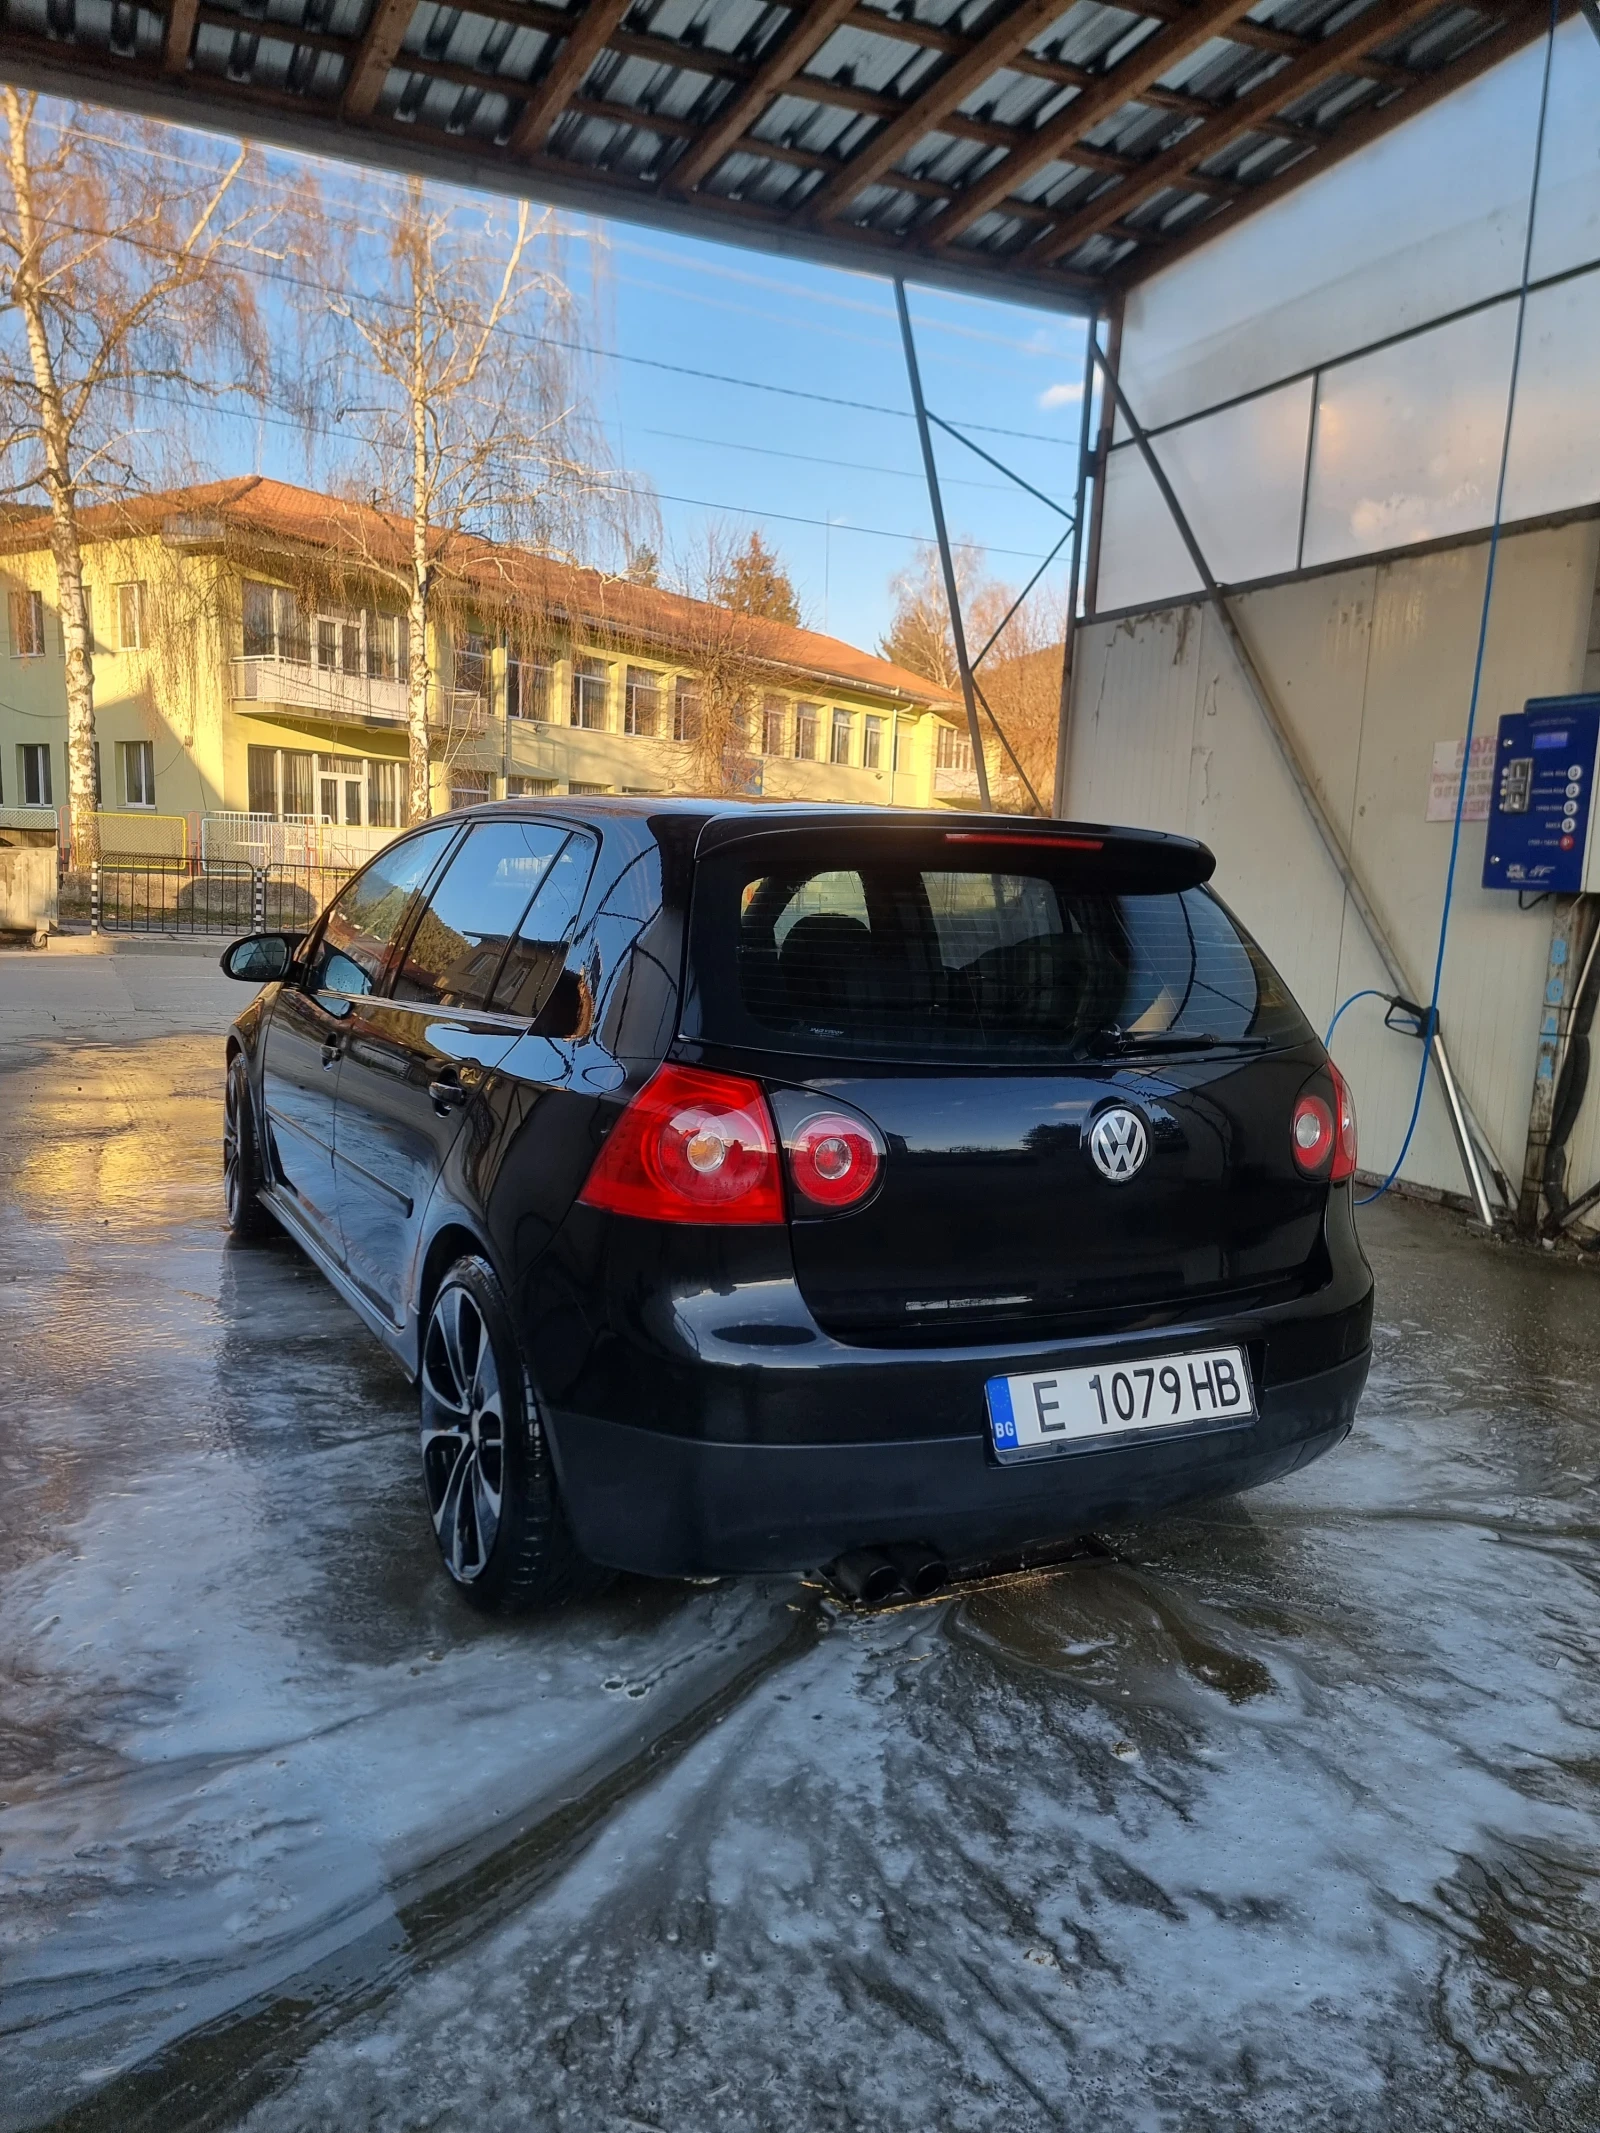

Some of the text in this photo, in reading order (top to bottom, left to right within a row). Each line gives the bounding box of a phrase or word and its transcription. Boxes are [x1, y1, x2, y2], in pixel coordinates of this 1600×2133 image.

[1032, 1358, 1241, 1433] E 1079 HB
[995, 1421, 1014, 1438] BG
